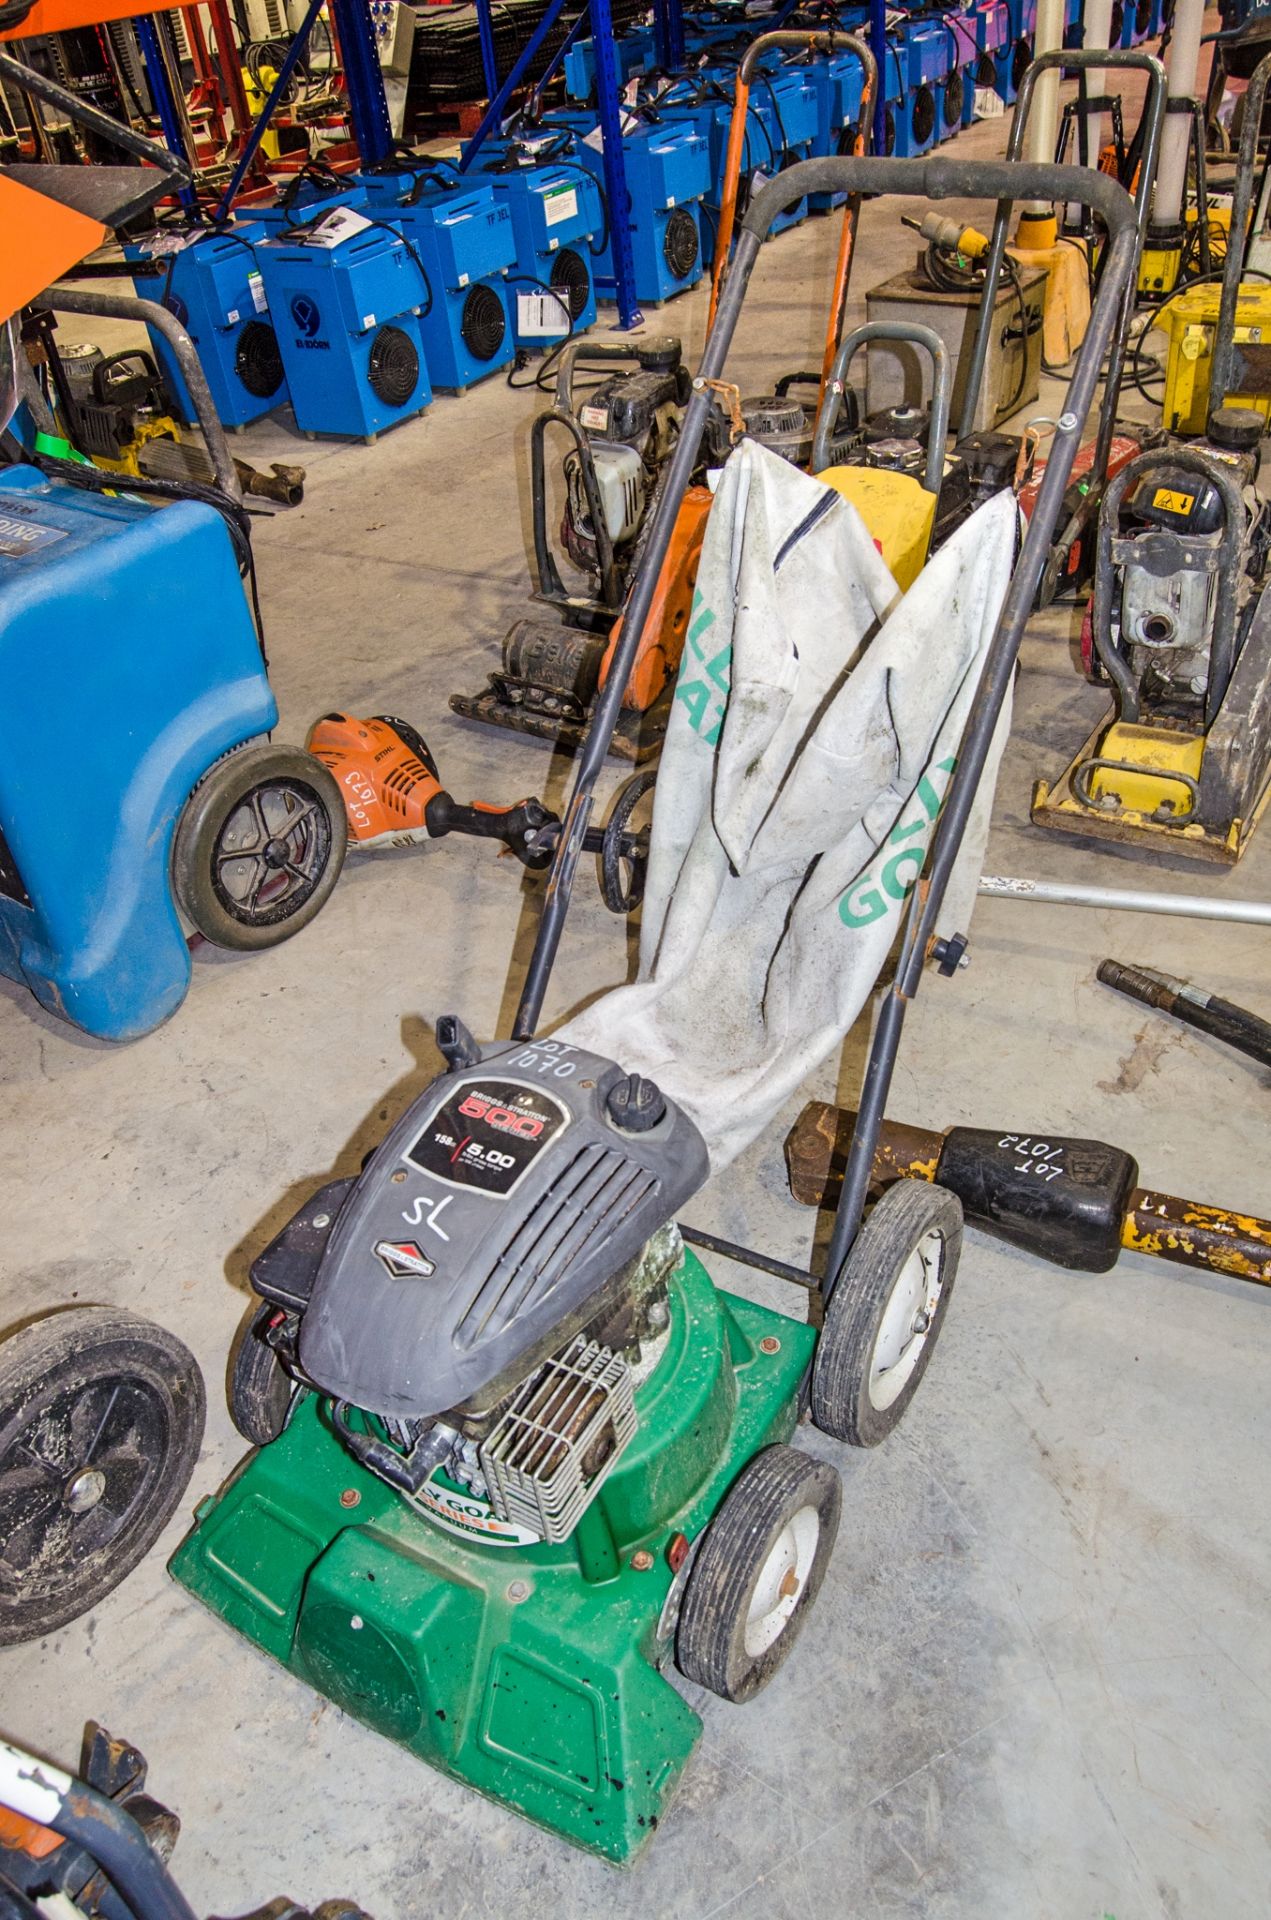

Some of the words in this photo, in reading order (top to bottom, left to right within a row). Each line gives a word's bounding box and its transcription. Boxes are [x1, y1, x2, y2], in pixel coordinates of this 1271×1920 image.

[374, 744, 396, 763] STIHL
[530, 1039, 579, 1056] LOT
[507, 1050, 577, 1078] 1070
[458, 1096, 545, 1137] 500
[466, 1142, 516, 1169] 5.00
[998, 1135, 1063, 1160] 1072
[1014, 1160, 1064, 1181] LOT
[401, 1195, 454, 1241] SL
